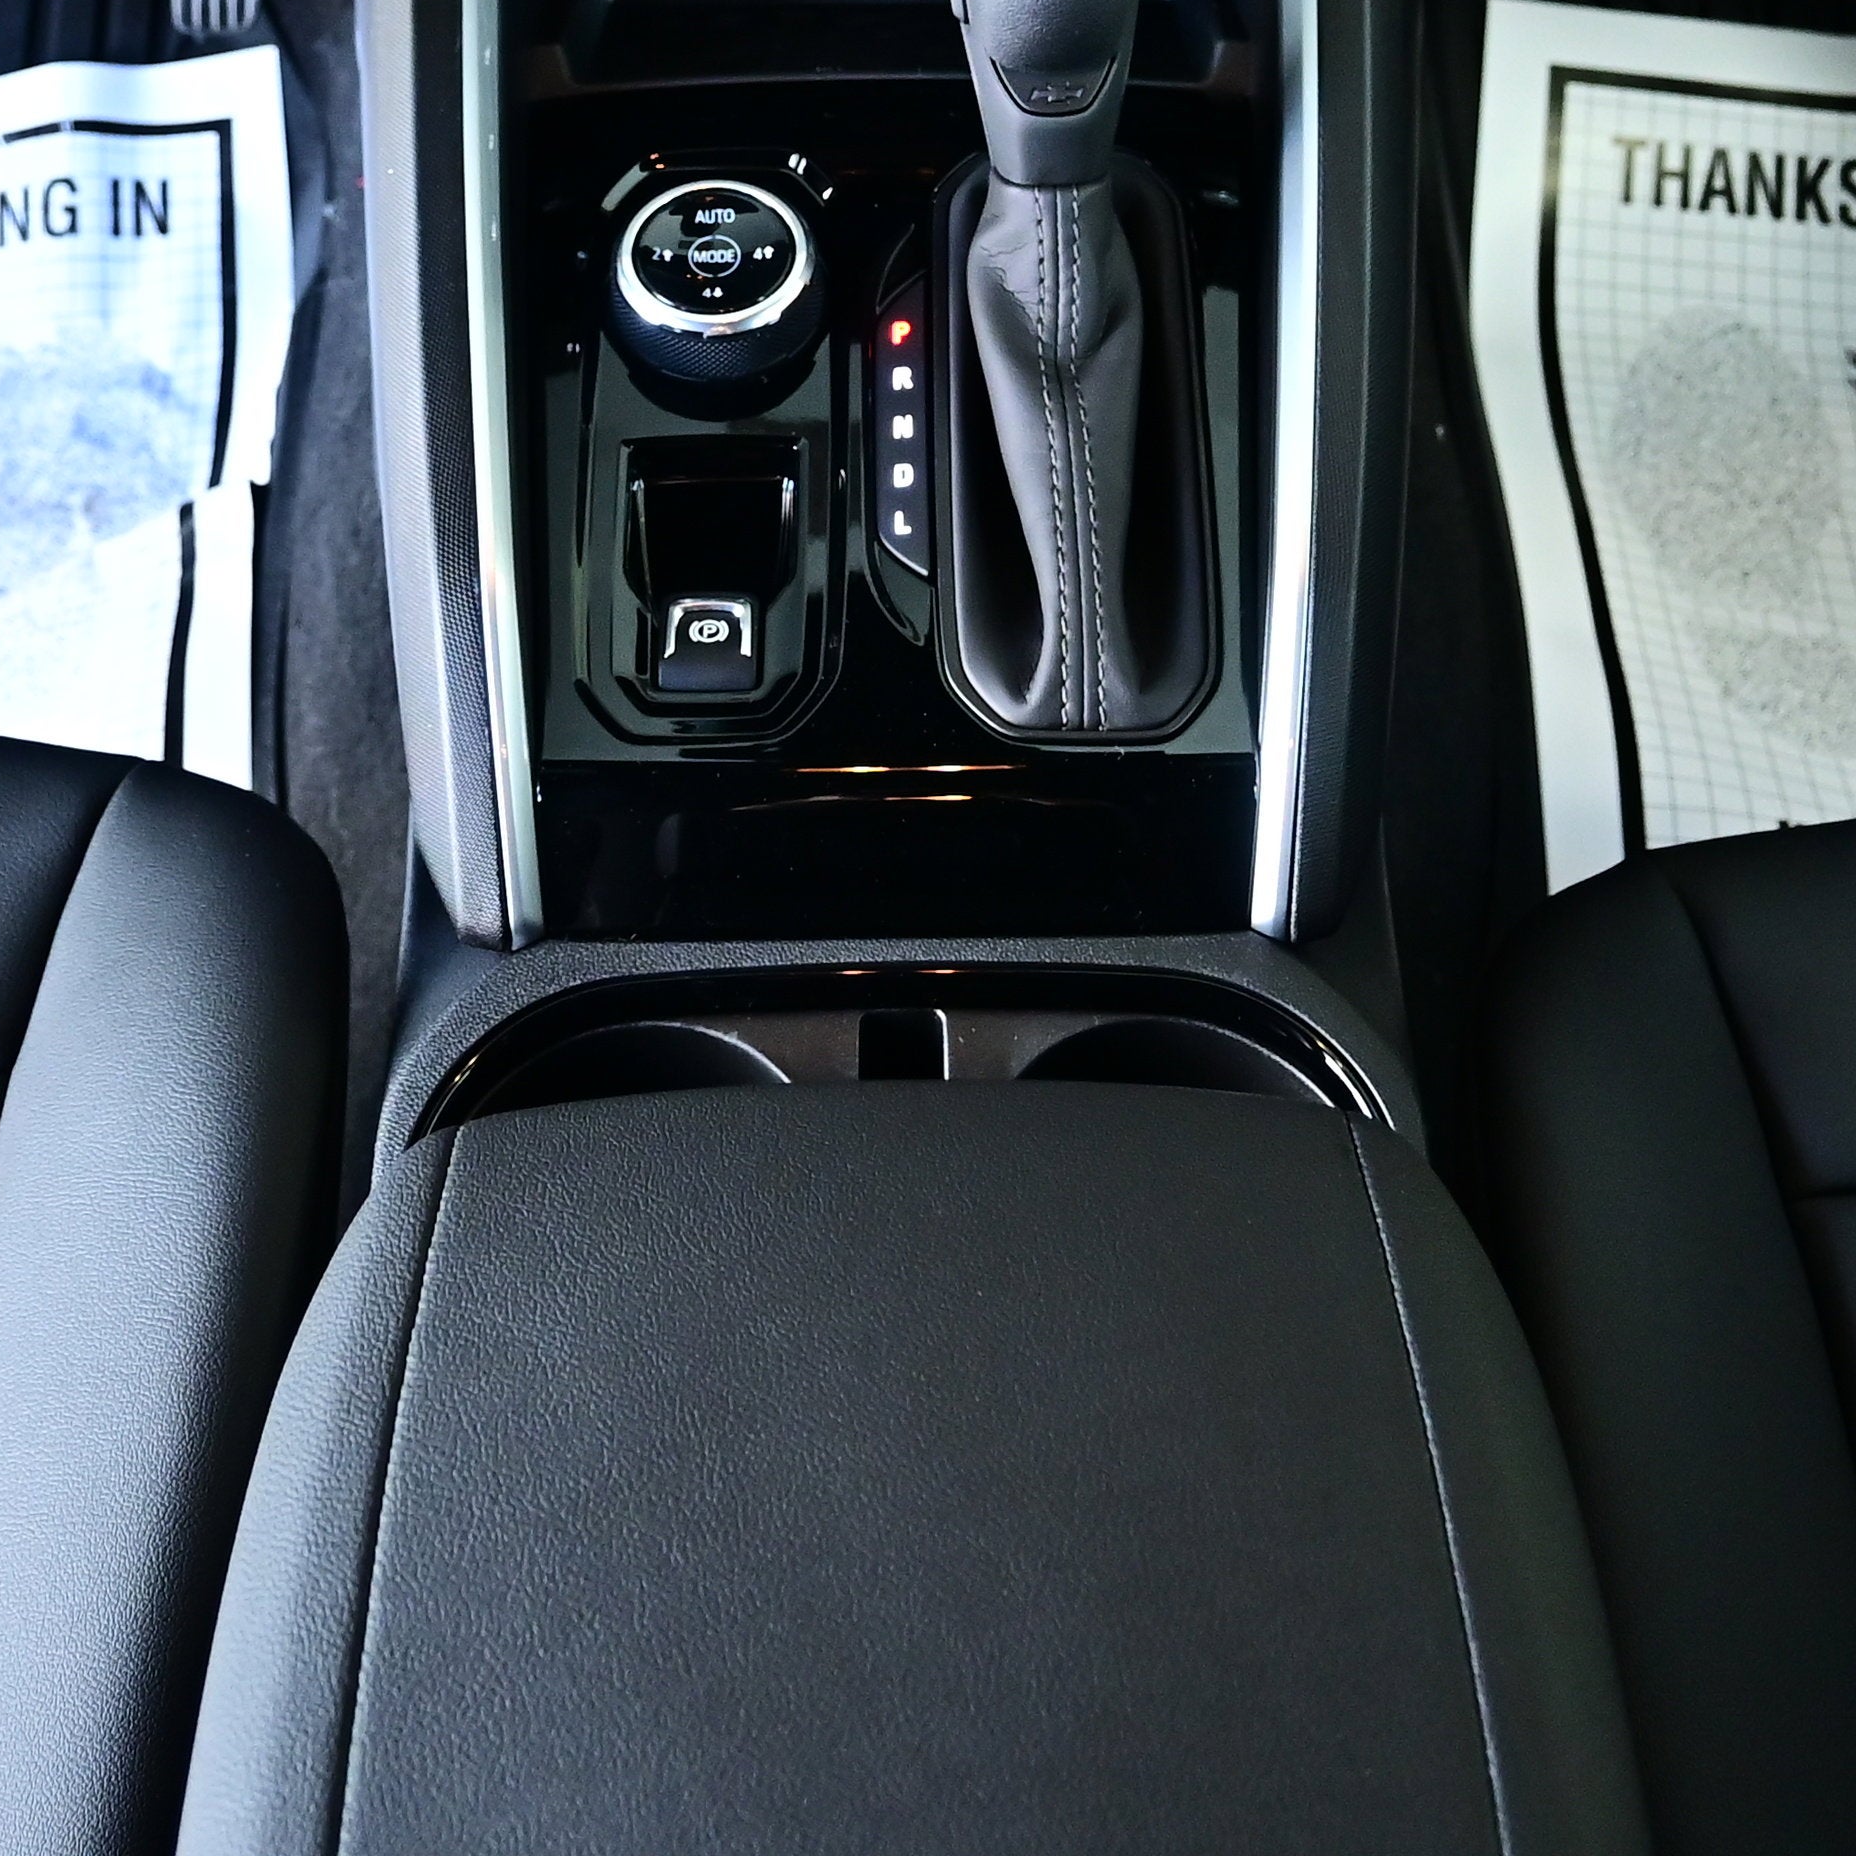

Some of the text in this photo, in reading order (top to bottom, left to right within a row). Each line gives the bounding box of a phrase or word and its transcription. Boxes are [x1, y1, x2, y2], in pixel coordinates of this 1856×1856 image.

[108, 177, 174, 240] IN
[695, 208, 736, 224] AUTO
[693, 248, 736, 264] MODE
[890, 320, 911, 345] P
[892, 366, 914, 391] R
[892, 414, 914, 439] N
[893, 463, 914, 488] D
[894, 511, 912, 535] L
